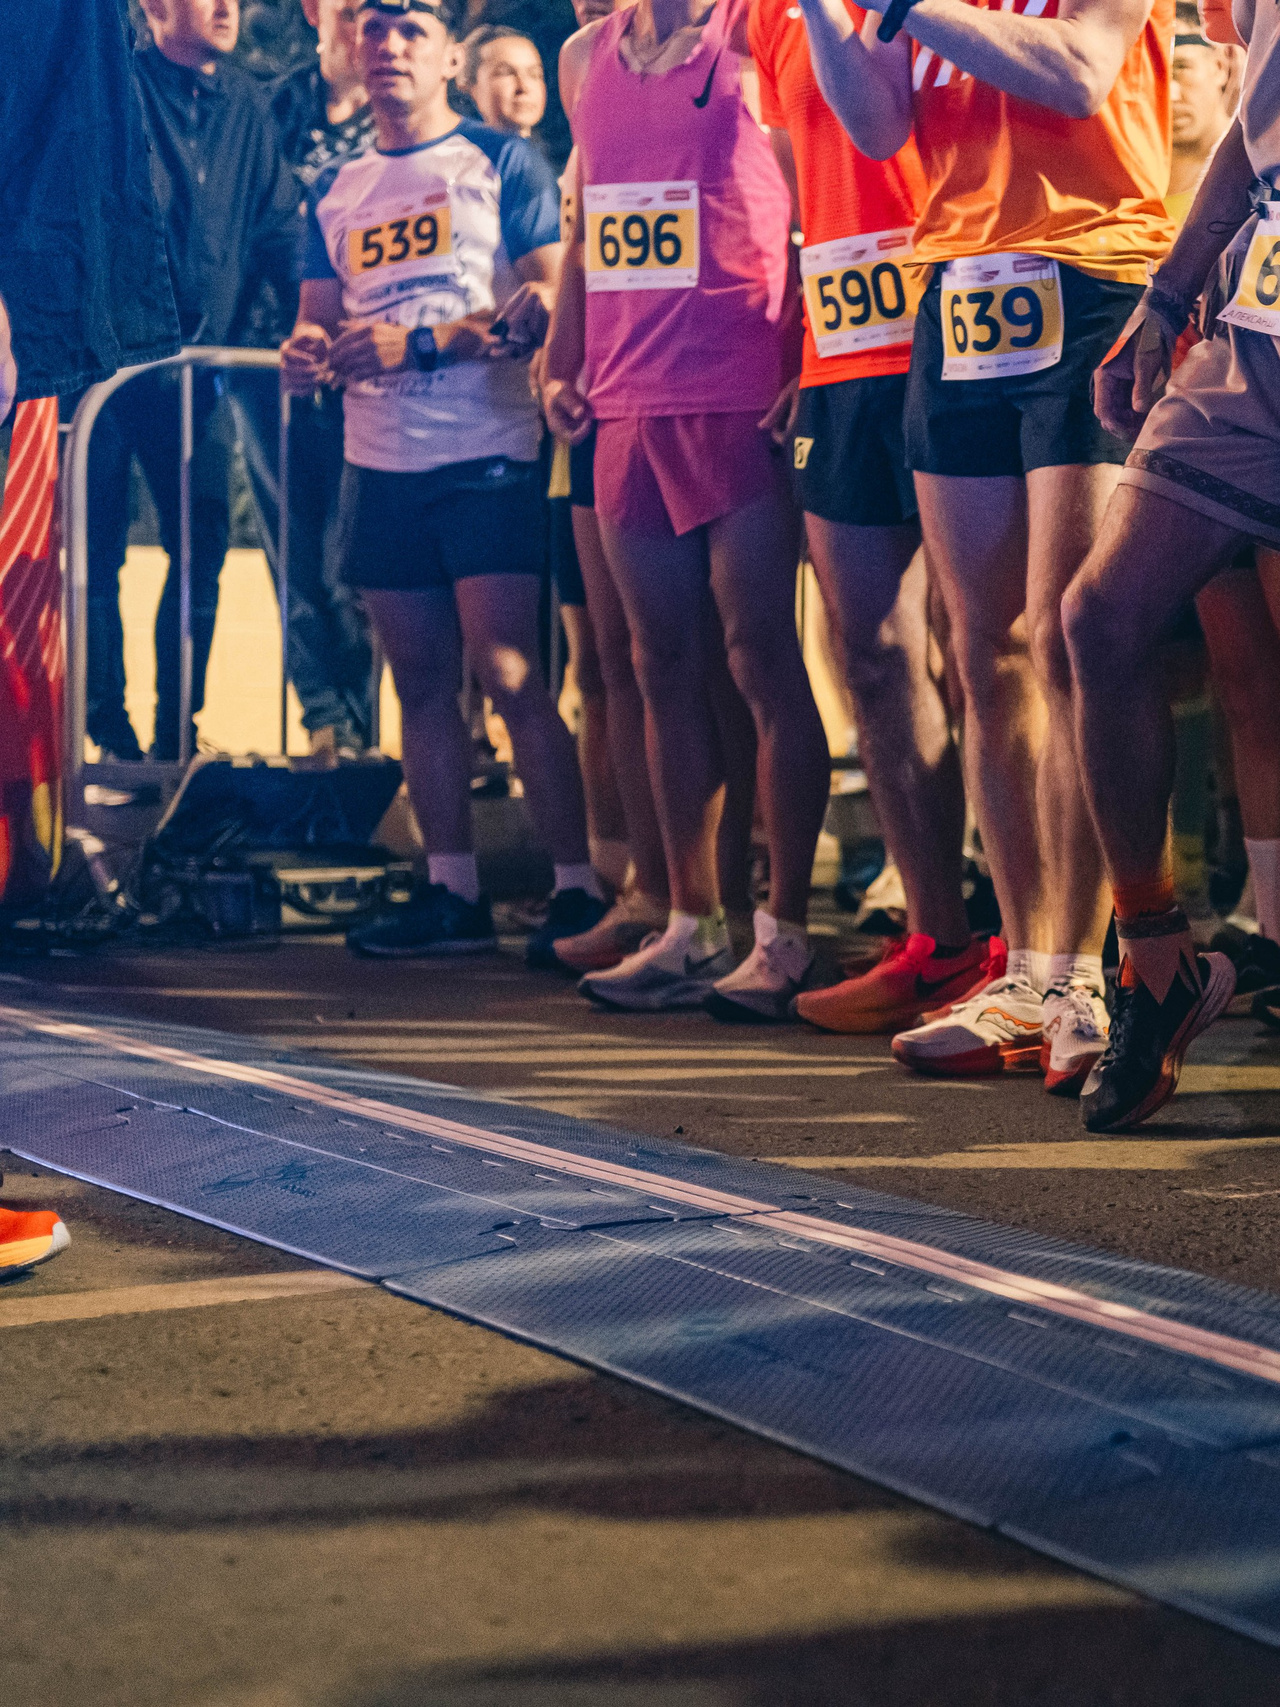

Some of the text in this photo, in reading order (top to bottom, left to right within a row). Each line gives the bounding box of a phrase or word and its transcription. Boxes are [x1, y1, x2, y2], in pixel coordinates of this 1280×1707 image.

[362, 214, 438, 269] 539
[599, 213, 682, 267] 696
[818, 262, 906, 330] 590
[951, 286, 1044, 353] 639
